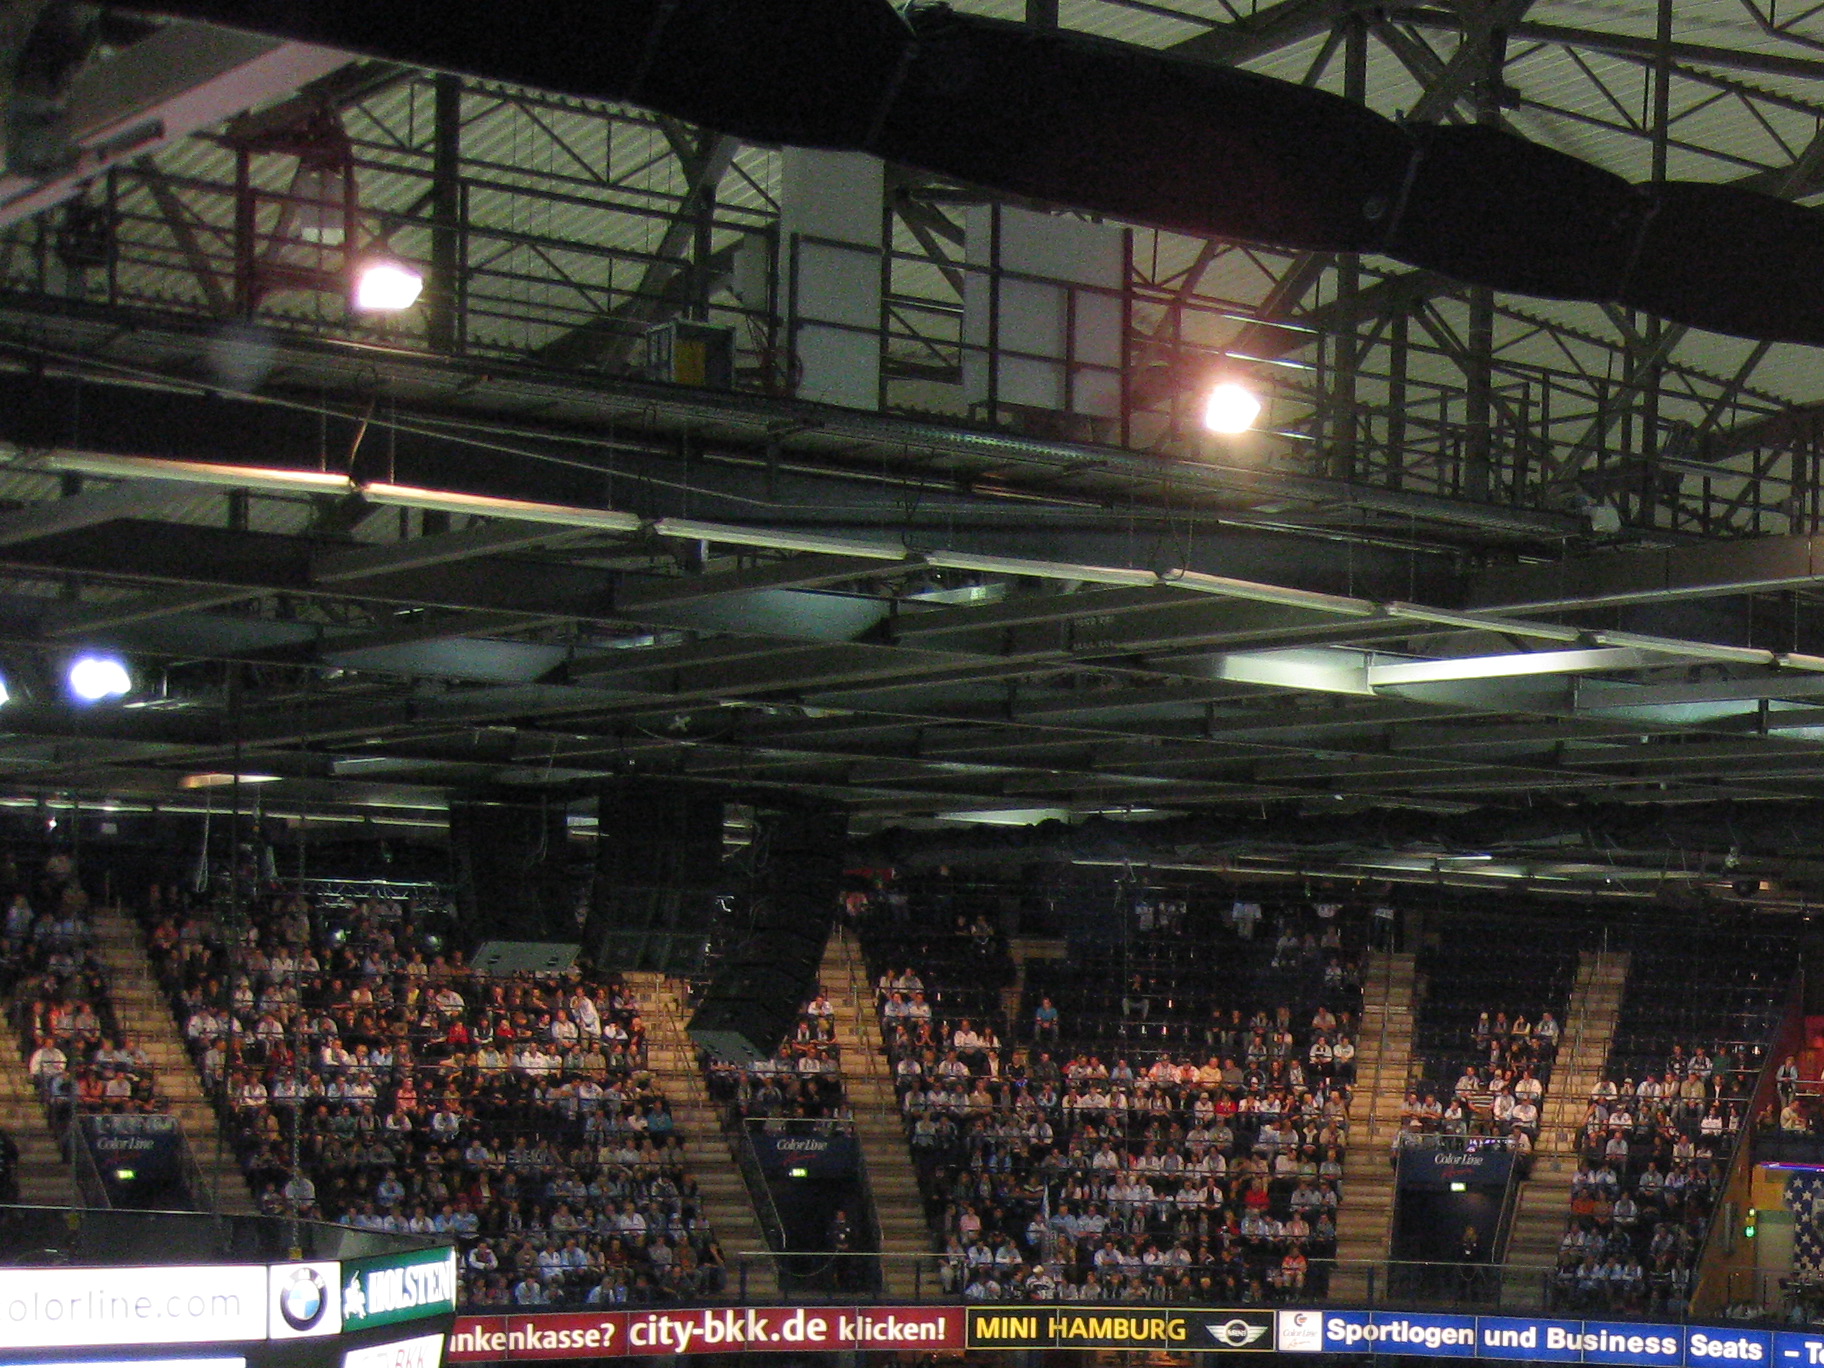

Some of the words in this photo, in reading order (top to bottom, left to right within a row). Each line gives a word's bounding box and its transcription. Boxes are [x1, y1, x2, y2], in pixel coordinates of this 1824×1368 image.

[367, 1260, 453, 1315] HOLSTEN
[449, 1322, 616, 1353] nkenkasse?
[629, 1309, 827, 1353] city-bkk.de
[838, 1316, 946, 1342] klicken!
[976, 1317, 1037, 1340] MINI
[1048, 1317, 1187, 1341] HAMBURG
[1327, 1317, 1474, 1348] Sportlogen
[1484, 1324, 1536, 1348] und
[1546, 1327, 1678, 1355] Business
[1690, 1333, 1763, 1360] Seats
